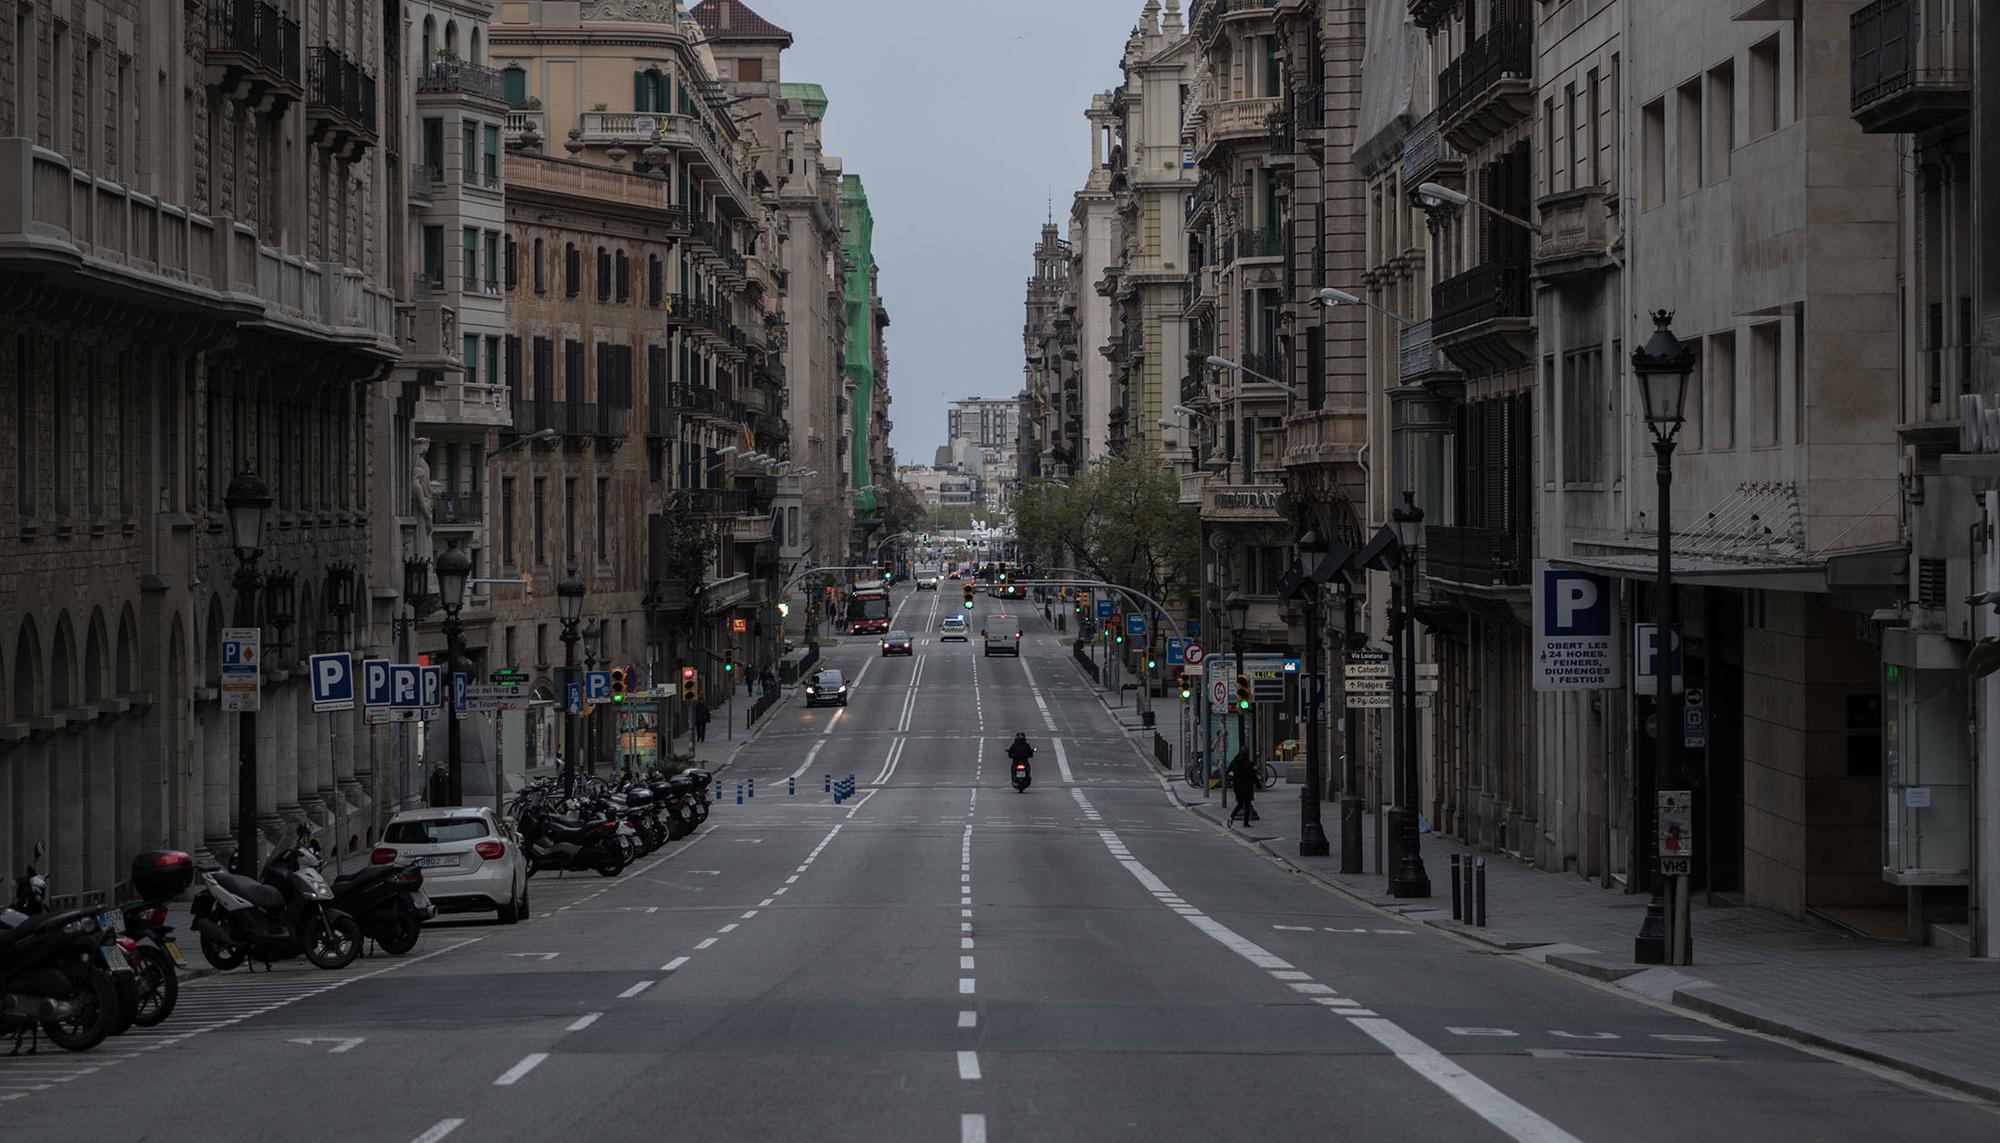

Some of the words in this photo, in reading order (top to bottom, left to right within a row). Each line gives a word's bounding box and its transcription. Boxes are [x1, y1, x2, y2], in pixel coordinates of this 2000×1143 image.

[1556, 578, 1598, 628] P
[226, 643, 236, 663] P
[1547, 642, 1584, 650] OBERT
[1588, 642, 1608, 650] LES
[1548, 650, 1562, 658] 24
[319, 660, 344, 697] P
[369, 665, 386, 700] P
[1545, 667, 1610, 675] DIUMENGES
[1559, 676, 1605, 684] FESTIUS
[395, 670, 415, 703] P
[457, 677, 465, 706] P
[590, 673, 606, 699] P
[1358, 681, 1384, 689] Platges
